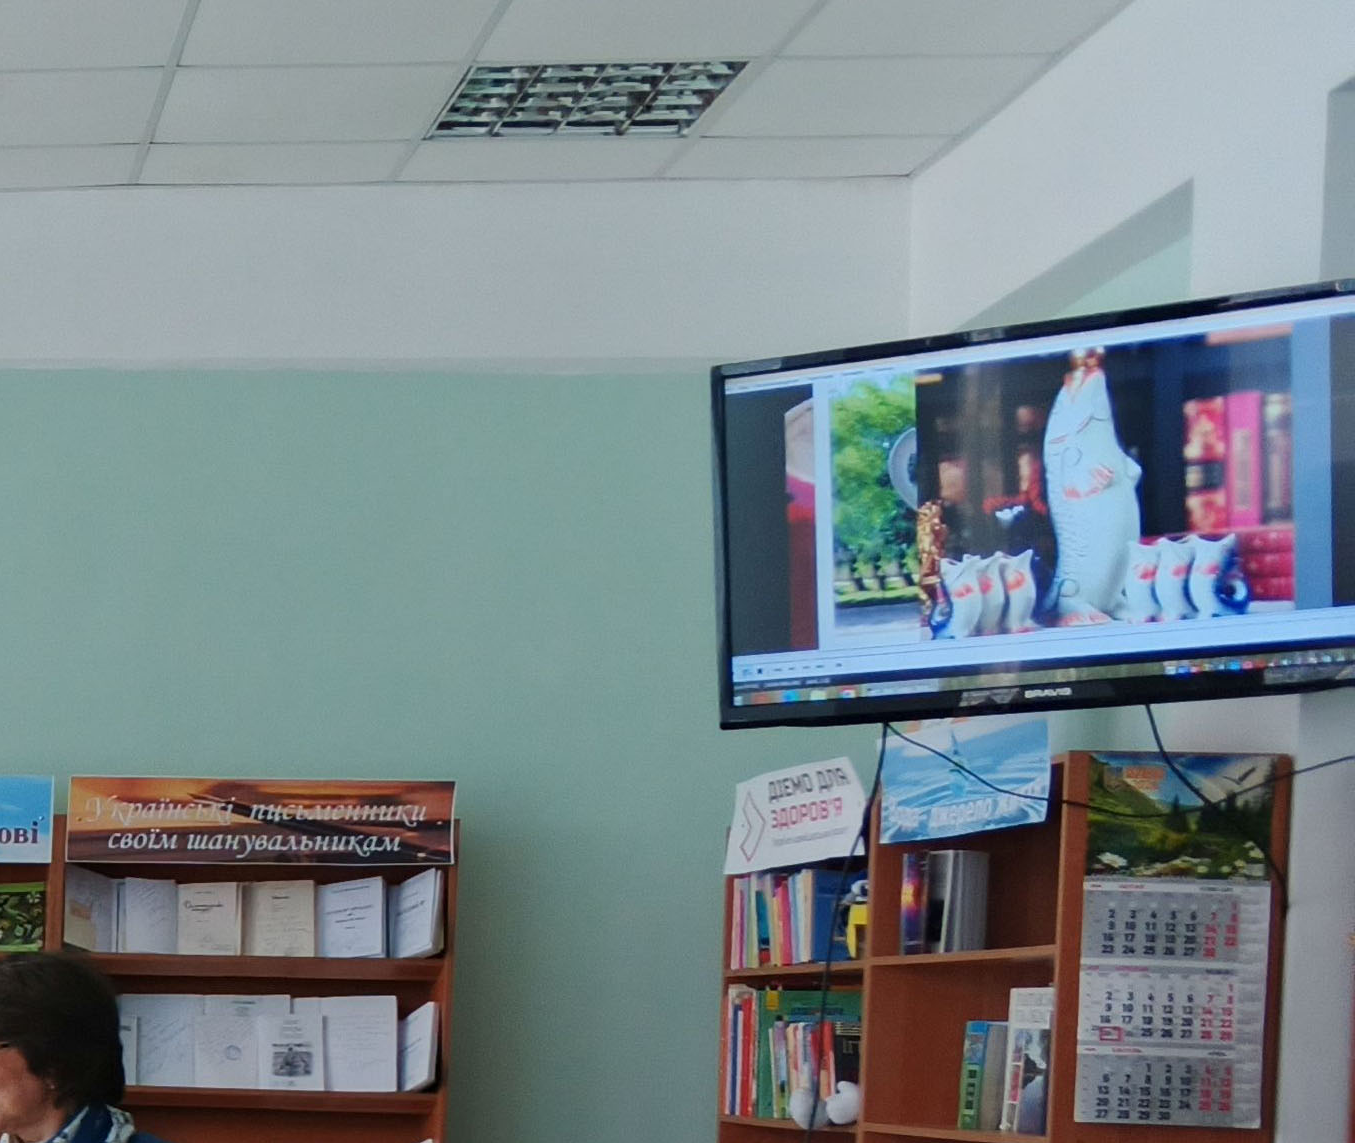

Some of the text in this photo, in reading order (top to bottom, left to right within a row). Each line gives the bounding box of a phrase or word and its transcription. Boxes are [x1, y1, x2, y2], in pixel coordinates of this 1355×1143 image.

[84, 796, 427, 827] Українські письменники
[107, 828, 401, 858] своїм шанувальникам
